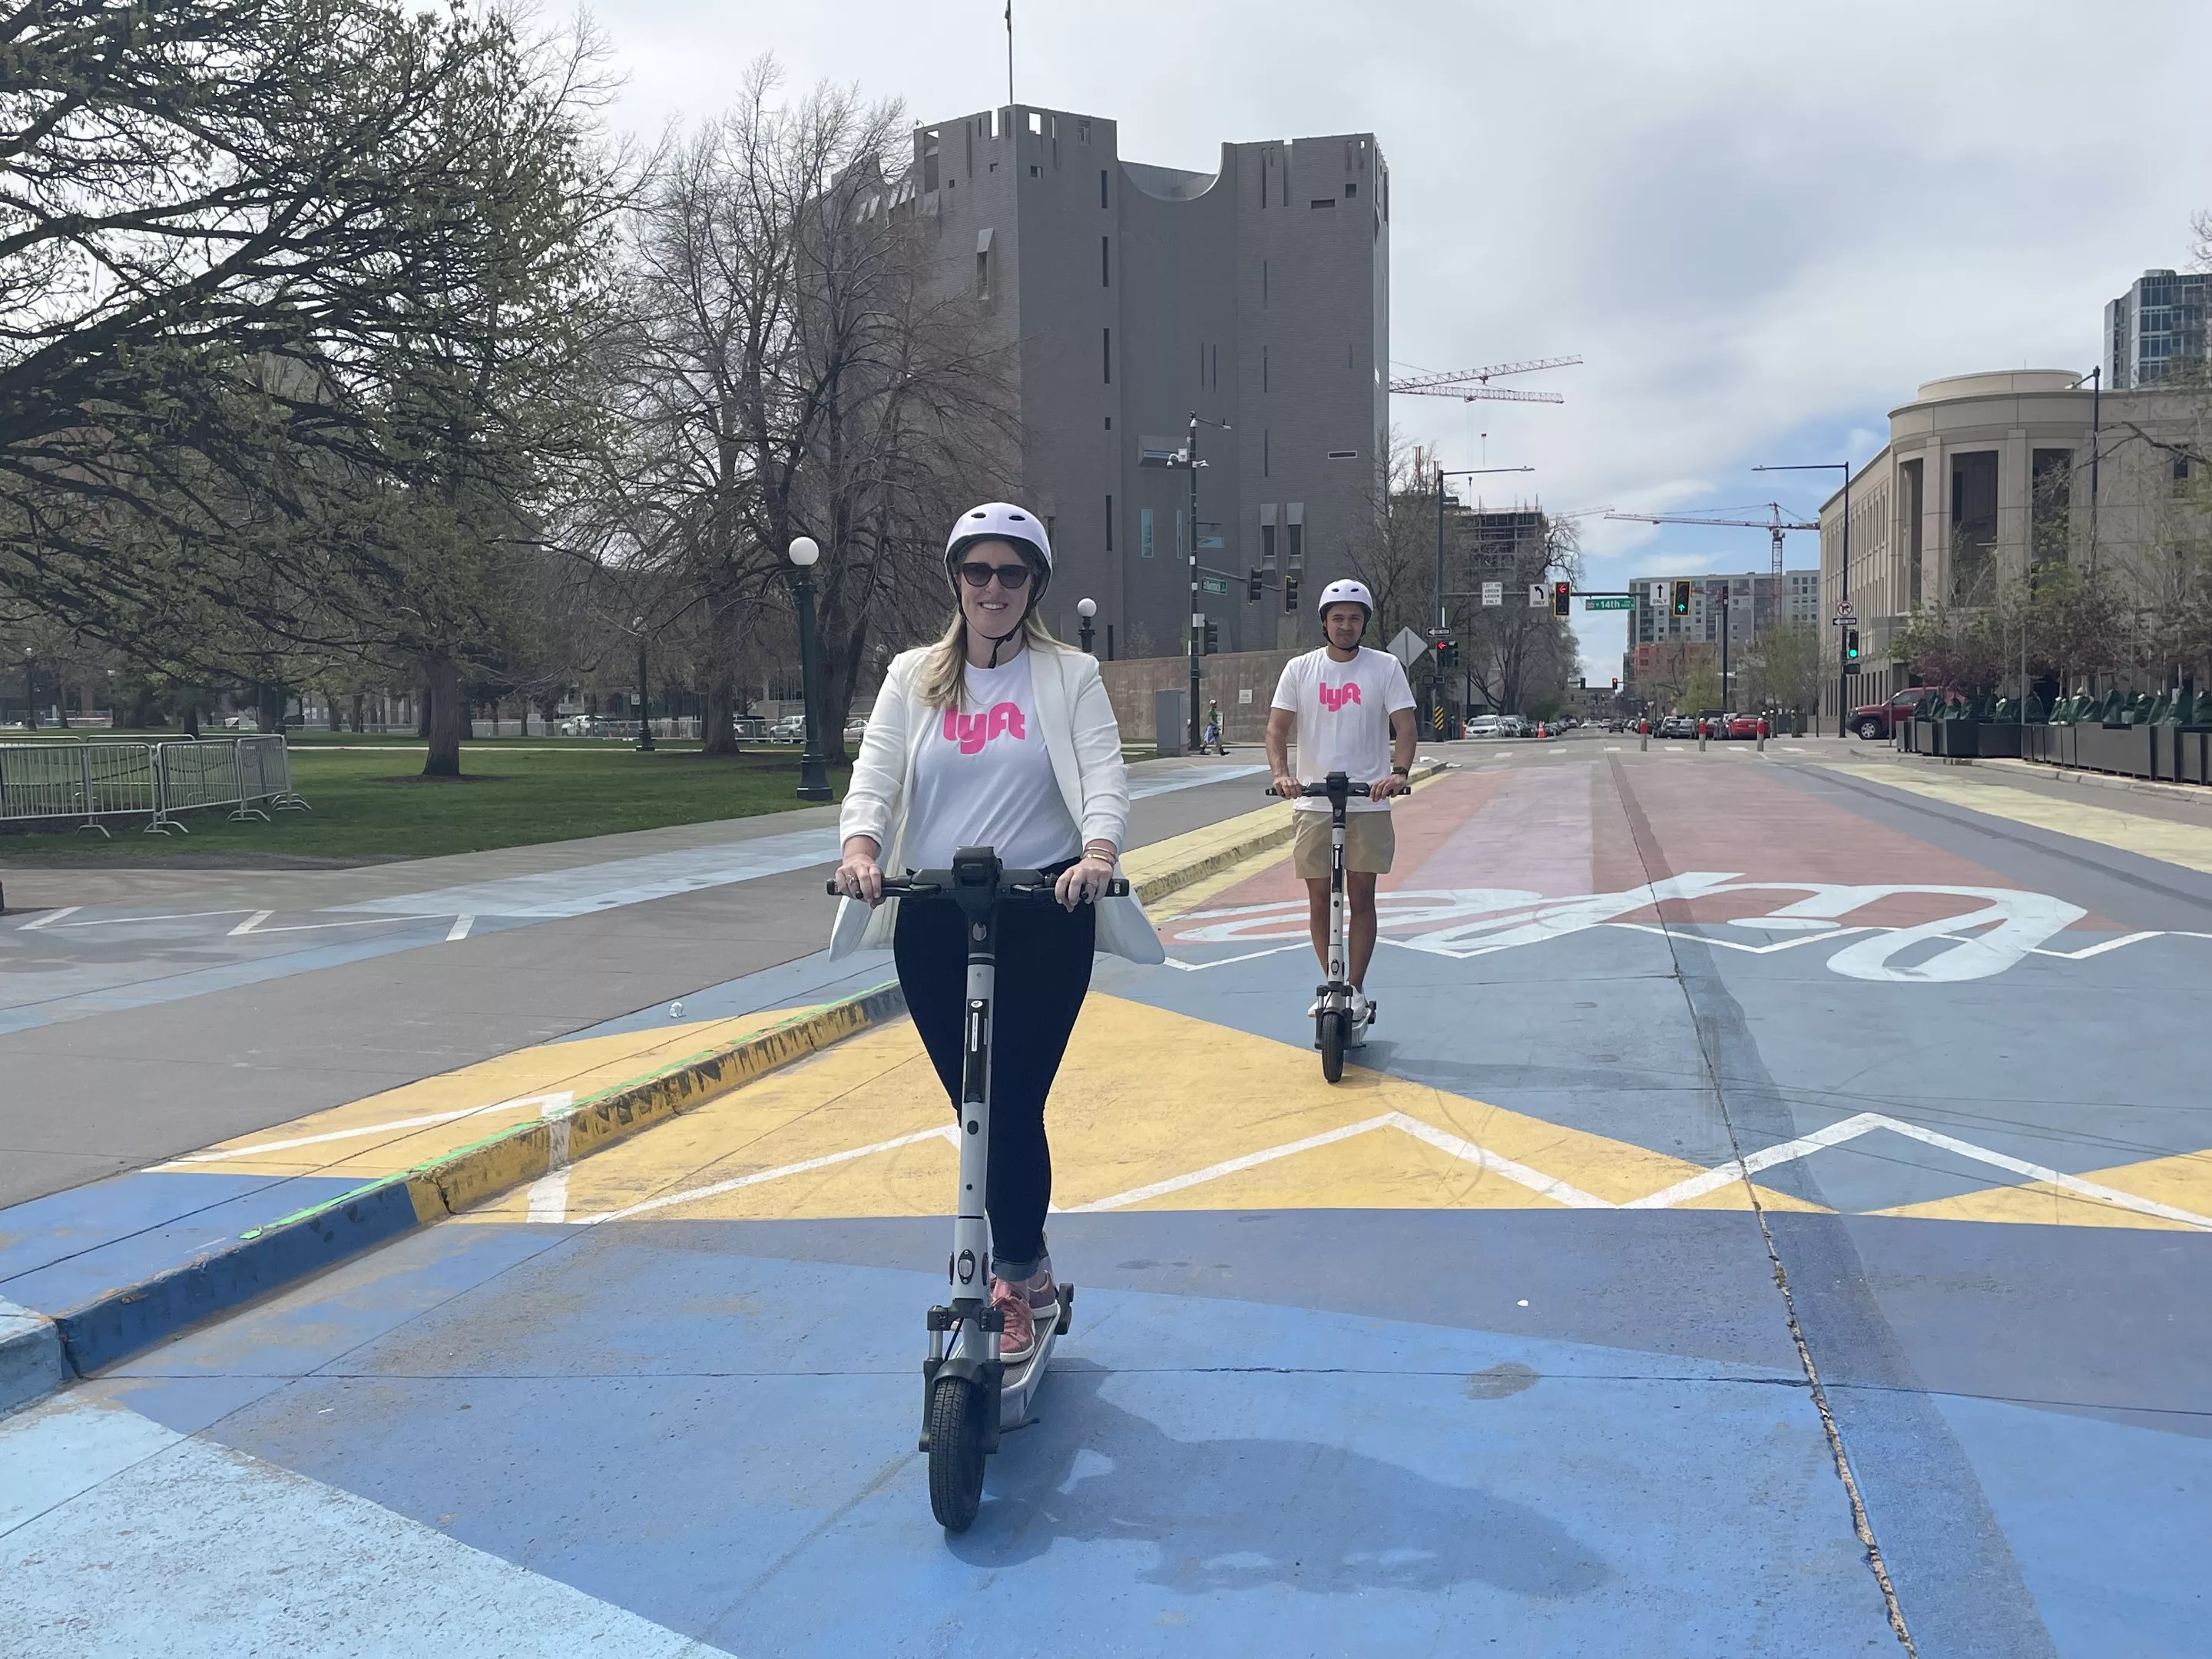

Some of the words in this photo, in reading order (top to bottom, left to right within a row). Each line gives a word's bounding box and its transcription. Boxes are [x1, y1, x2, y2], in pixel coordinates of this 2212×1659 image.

[1601, 600, 1621, 608] 14th
[1319, 681, 1362, 713] lyft
[942, 700, 1026, 755] lyft
